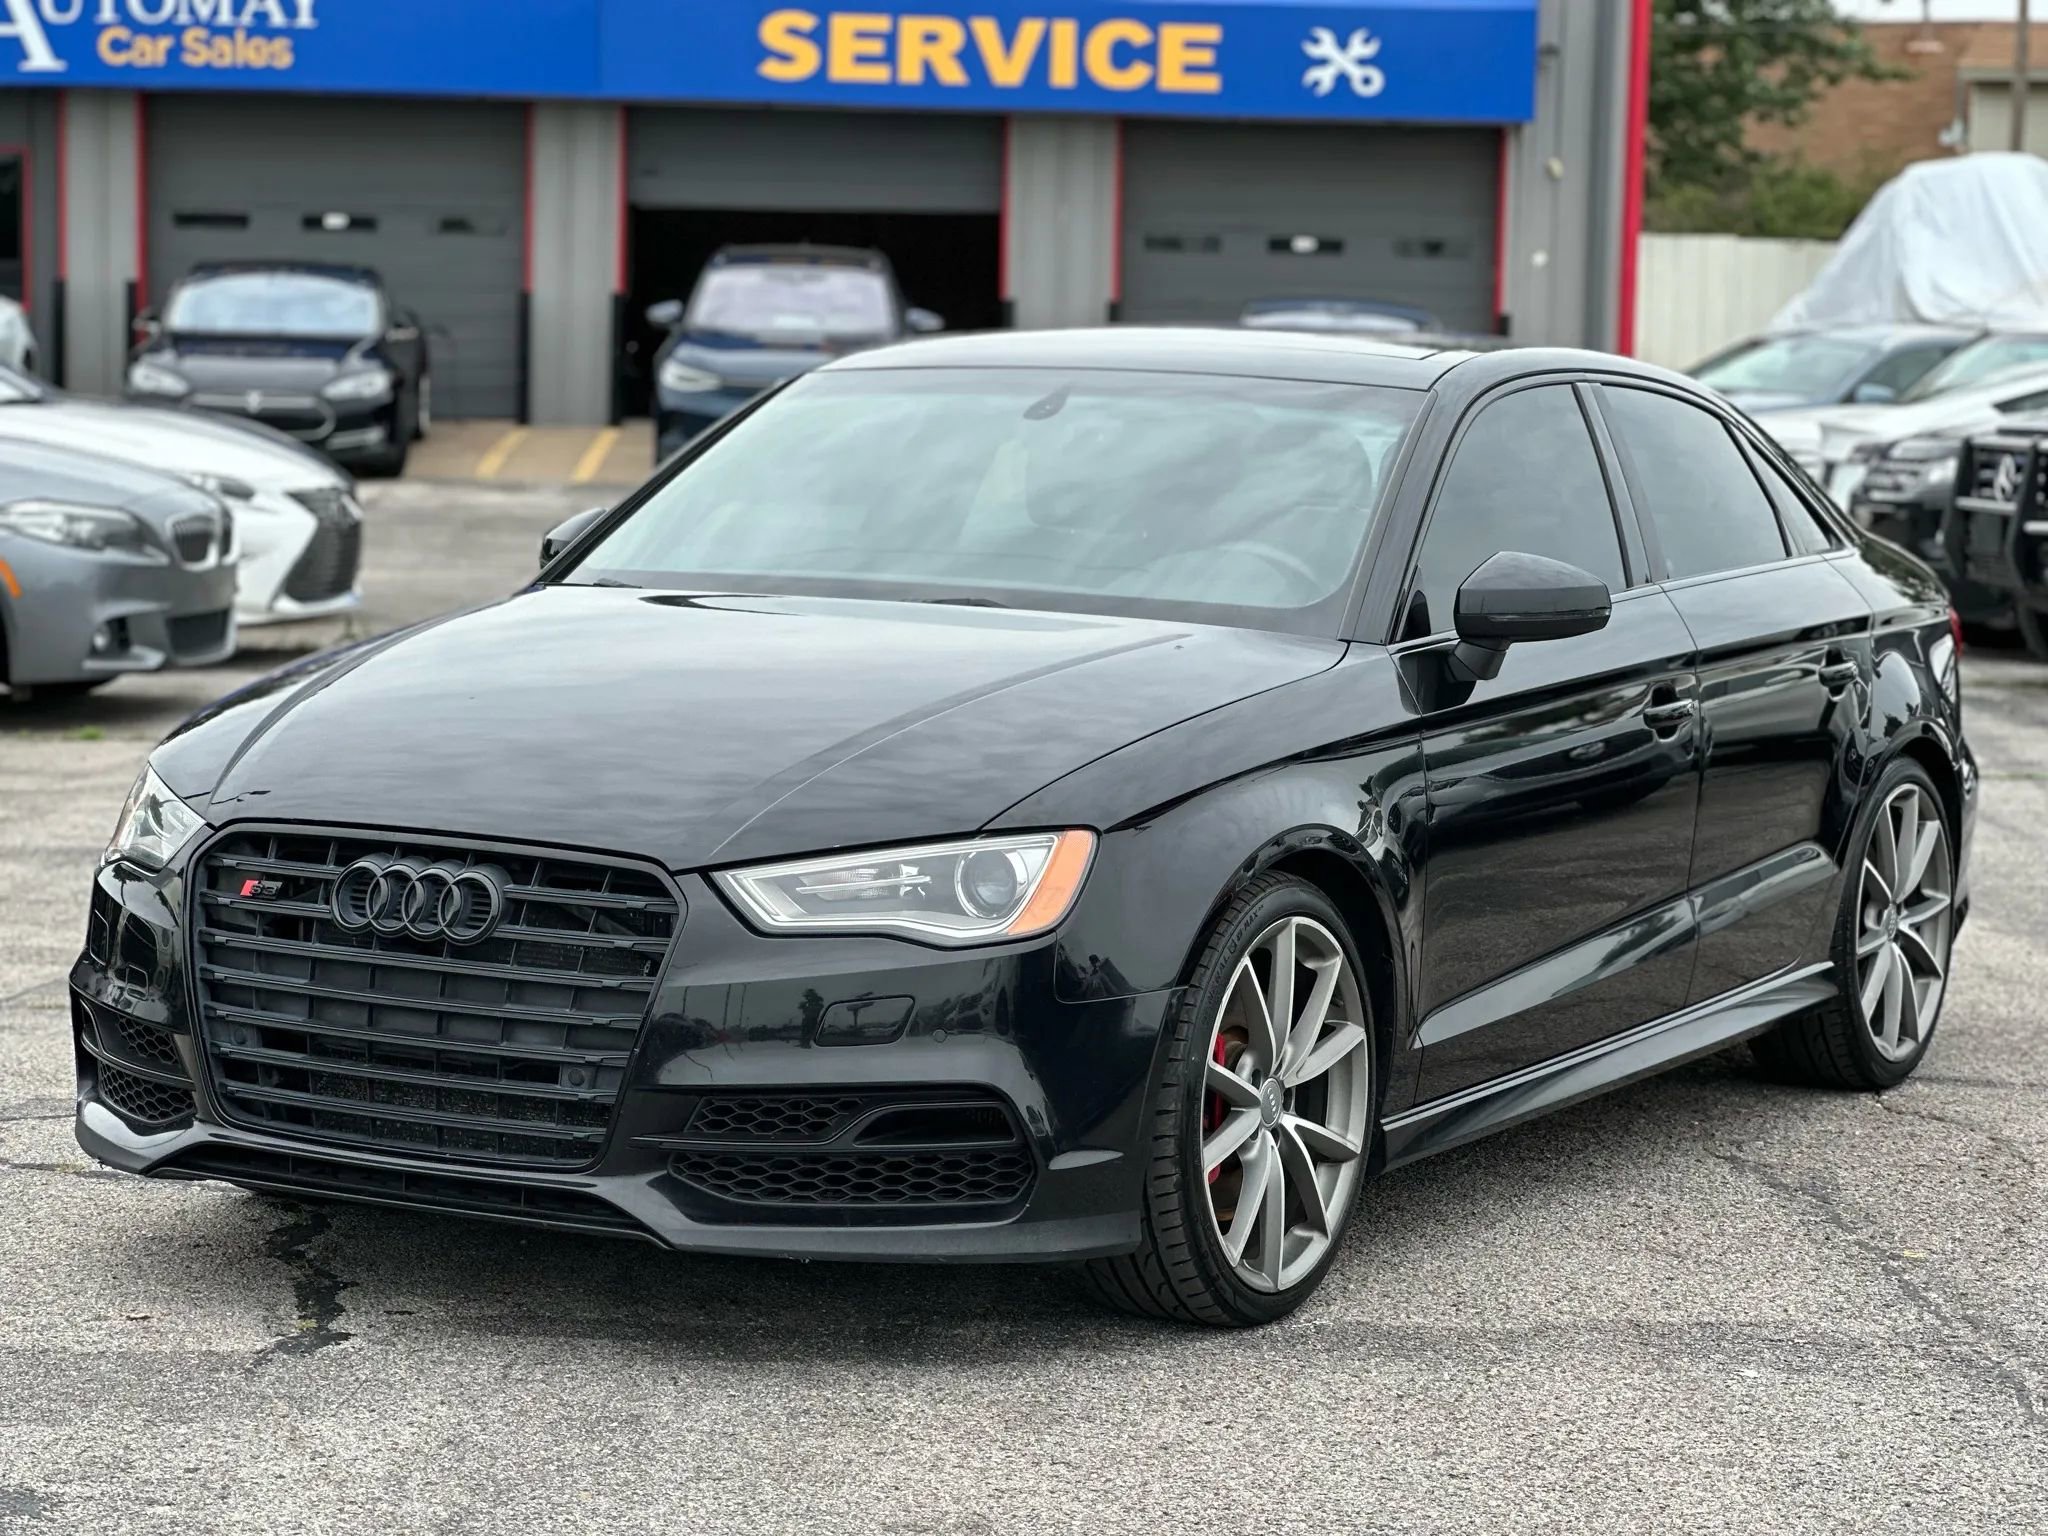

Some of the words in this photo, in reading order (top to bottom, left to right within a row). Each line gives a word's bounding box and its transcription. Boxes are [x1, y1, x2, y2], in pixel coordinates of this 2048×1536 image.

[96, 24, 175, 67] Car
[180, 26, 295, 69] Sales
[756, 8, 1222, 94] SERVICE
[247, 880, 282, 899] S3
